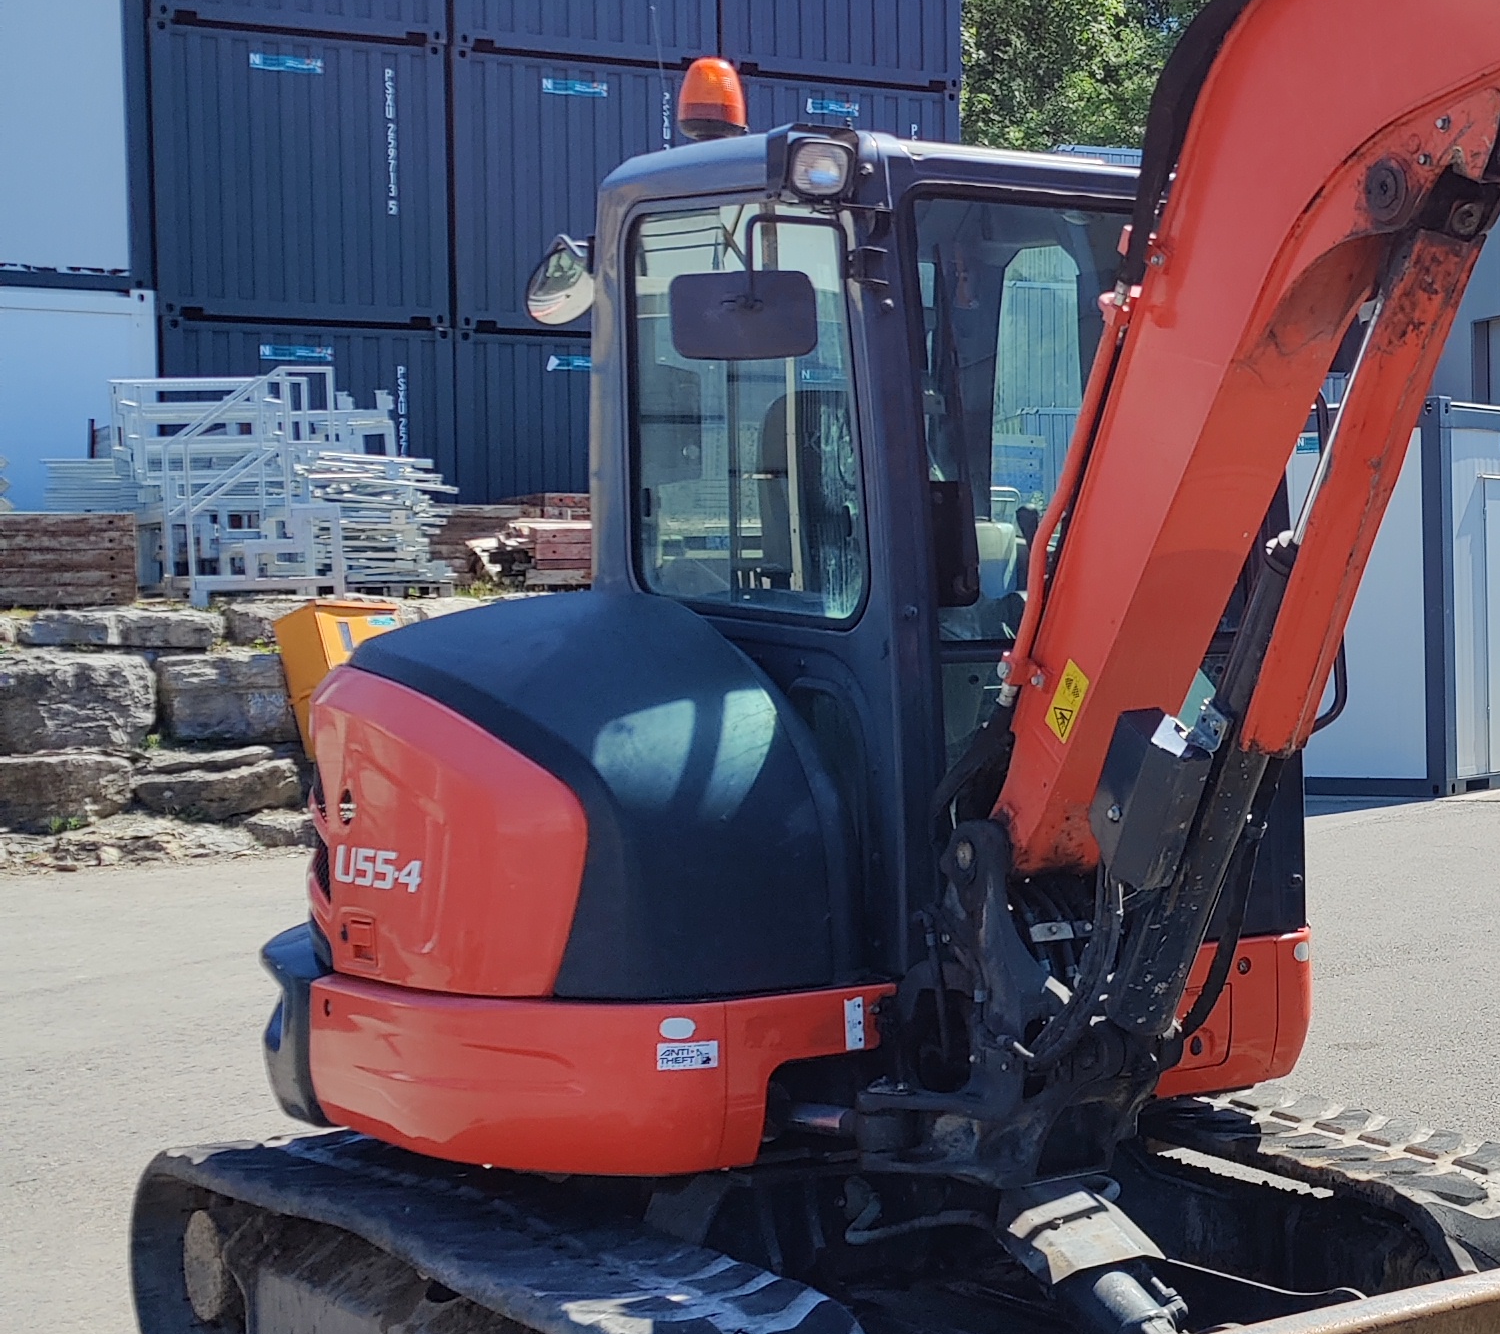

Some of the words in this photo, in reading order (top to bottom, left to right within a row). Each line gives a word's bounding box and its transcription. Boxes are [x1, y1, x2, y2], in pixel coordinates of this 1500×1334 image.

[384, 68, 396, 119] PSXU
[387, 123, 398, 197] 259713
[387, 200, 399, 215] 5
[397, 365, 407, 416] PSXU
[399, 417, 408, 458] 257
[659, 1056, 696, 1065] THEFT
[660, 1048, 690, 1057] ANTI
